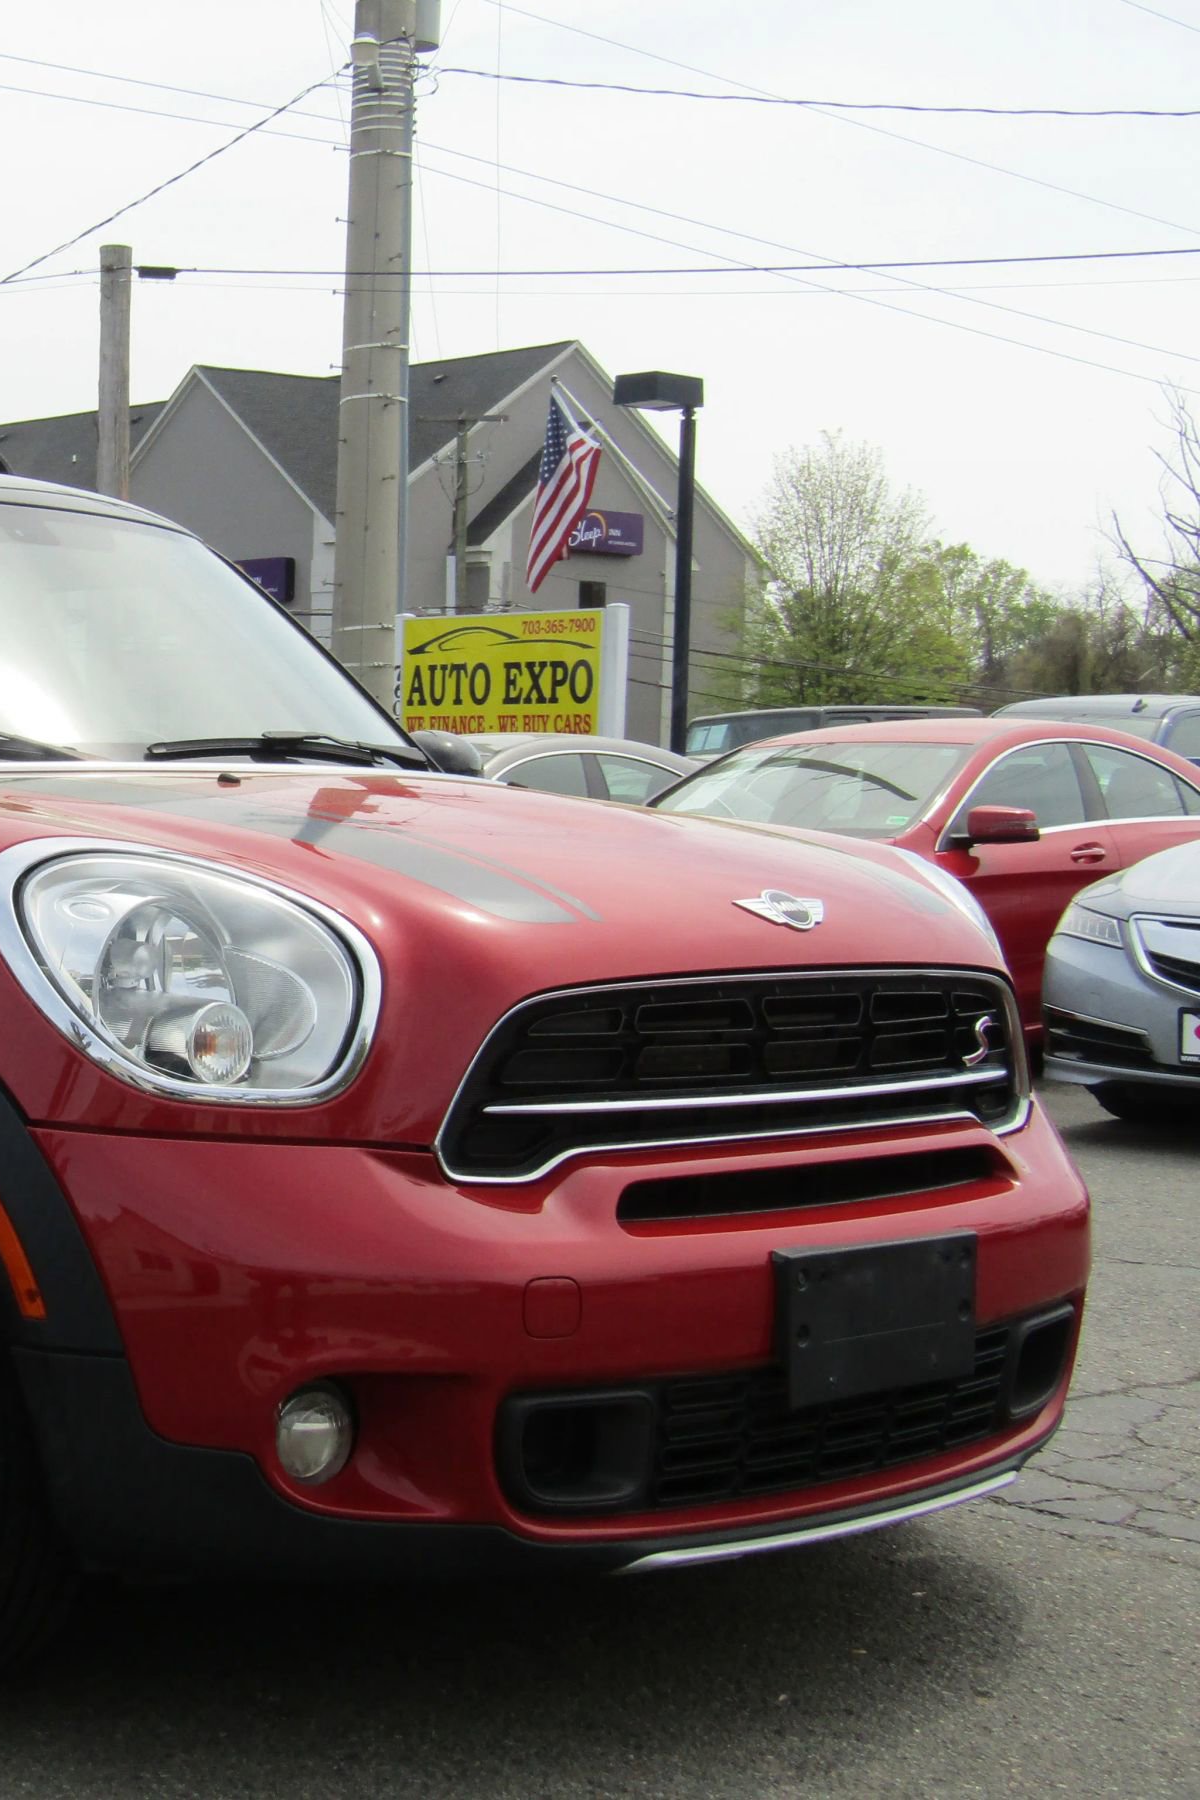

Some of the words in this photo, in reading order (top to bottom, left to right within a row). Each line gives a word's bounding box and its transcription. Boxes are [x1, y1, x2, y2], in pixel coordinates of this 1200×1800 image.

[568, 519, 603, 547] Sleep
[521, 617, 595, 635] 703-365-7900
[406, 662, 491, 706] AUTO
[502, 659, 593, 705] EXPO
[406, 715, 425, 733] WE
[429, 715, 485, 734] FINANCE
[496, 714, 520, 733] WE
[523, 714, 550, 733] BUY
[553, 713, 592, 734] CARS
[962, 1015, 993, 1067] S
